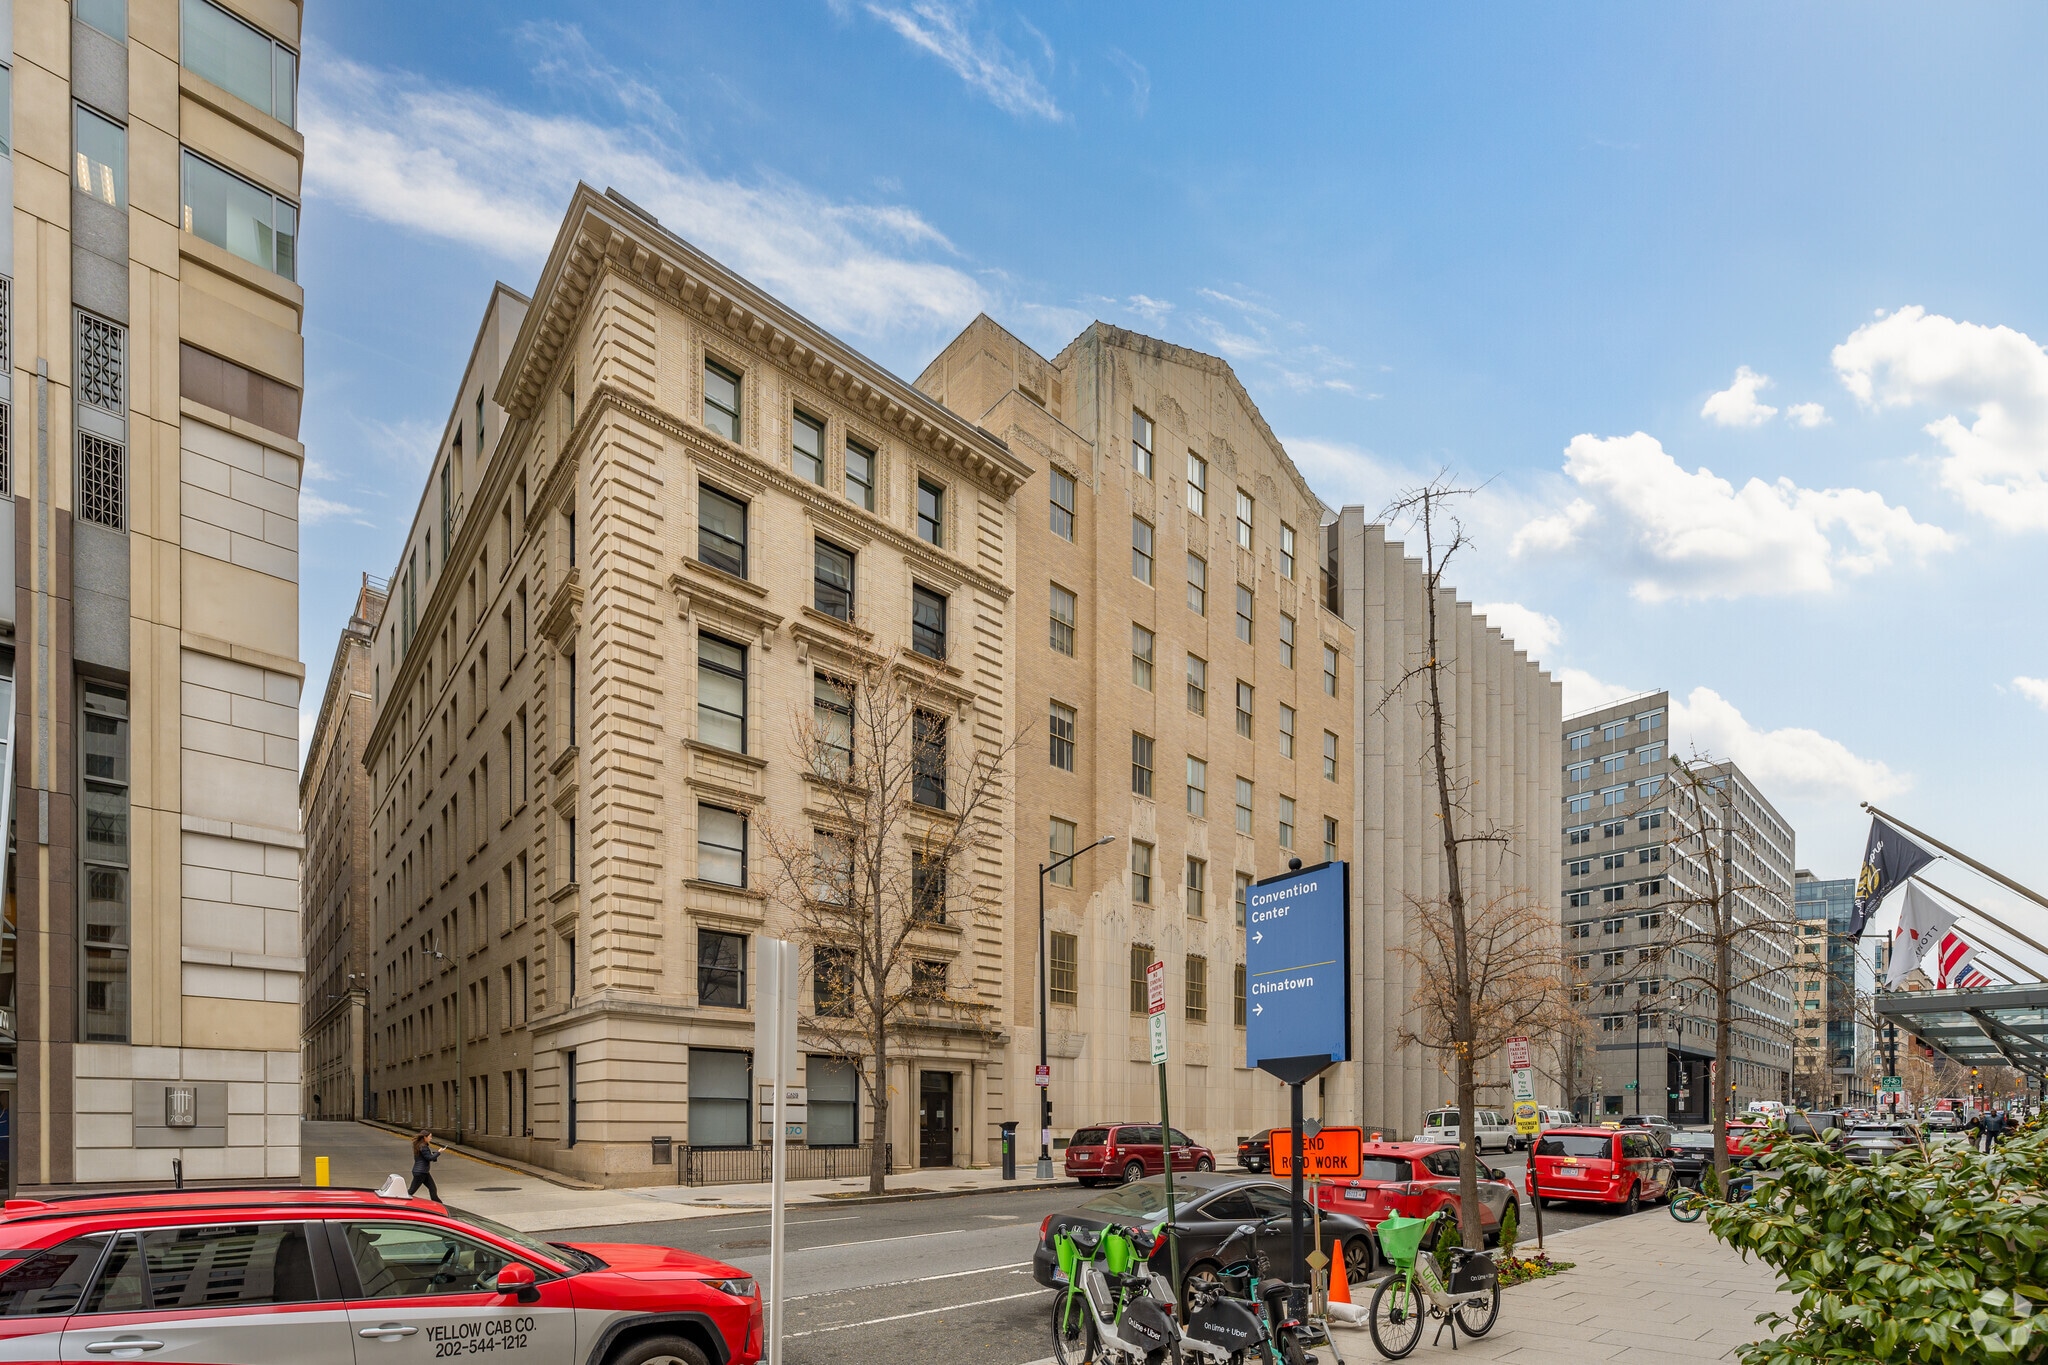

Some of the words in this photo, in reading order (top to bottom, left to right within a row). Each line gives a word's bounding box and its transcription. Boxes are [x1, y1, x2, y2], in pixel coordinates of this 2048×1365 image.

[1251, 882, 1318, 906] Convention
[1251, 906, 1290, 923] Center
[1252, 977, 1313, 995] Chinatown
[1302, 1138, 1324, 1150] END
[1282, 1156, 1310, 1168] RD
[1315, 1156, 1348, 1168] WORK
[426, 1322, 481, 1342] YELLOW
[485, 1320, 512, 1336] CAB
[515, 1317, 536, 1332] CO.
[1128, 1317, 1134, 1325] On
[1134, 1320, 1143, 1332] Lime
[1147, 1328, 1161, 1340] Uber
[1212, 1323, 1225, 1333] Lime
[1231, 1328, 1247, 1338] Uber
[436, 1334, 527, 1358] 202-544-1212
